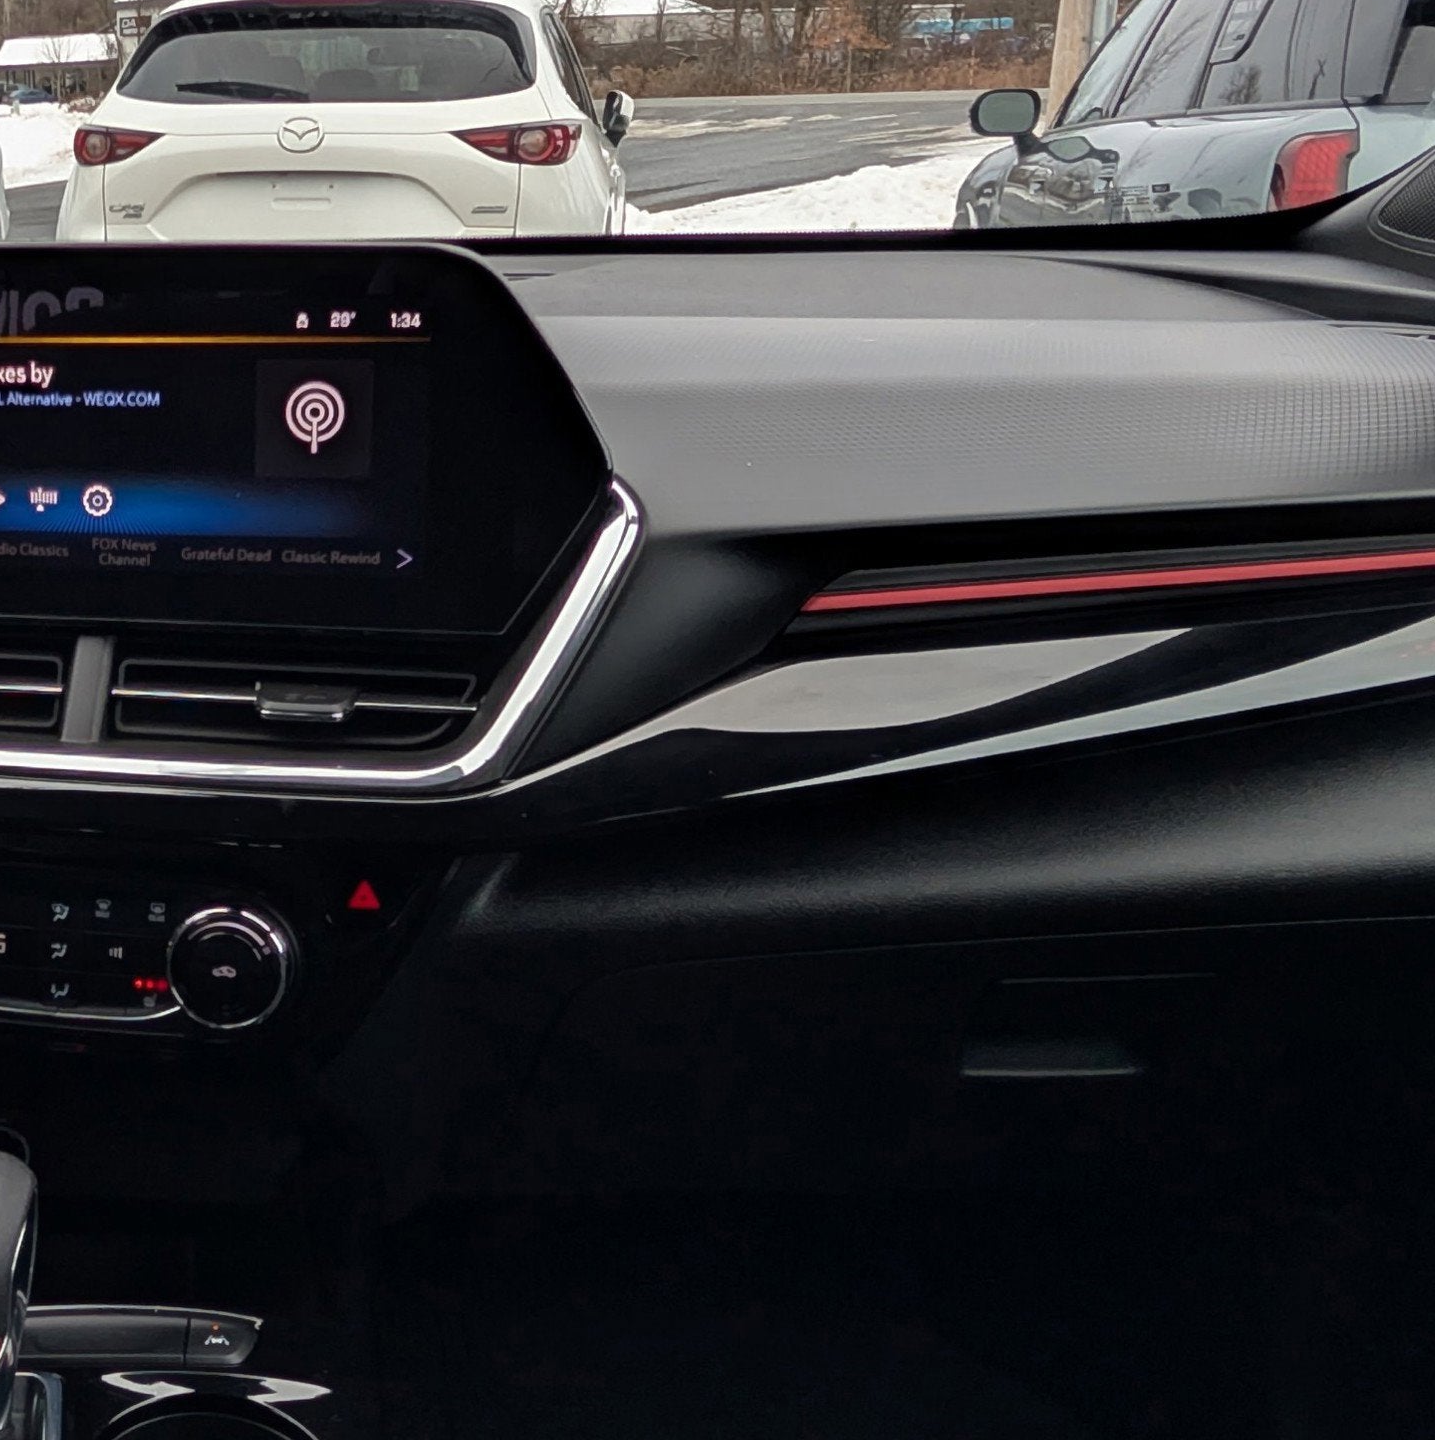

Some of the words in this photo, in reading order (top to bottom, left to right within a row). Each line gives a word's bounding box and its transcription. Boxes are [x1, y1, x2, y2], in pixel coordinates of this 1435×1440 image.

[391, 312, 422, 328] 1:34
[30, 360, 54, 389] by
[6, 390, 73, 407] Alternative
[82, 391, 161, 407] WEQX.COM
[19, 542, 70, 557] Classics
[91, 537, 118, 550] FOX
[121, 538, 157, 552] News
[98, 552, 152, 567] Channel
[181, 546, 235, 561] Grateful
[236, 548, 272, 563] Dead
[281, 549, 328, 565] Classic
[329, 550, 382, 566] Rewind
